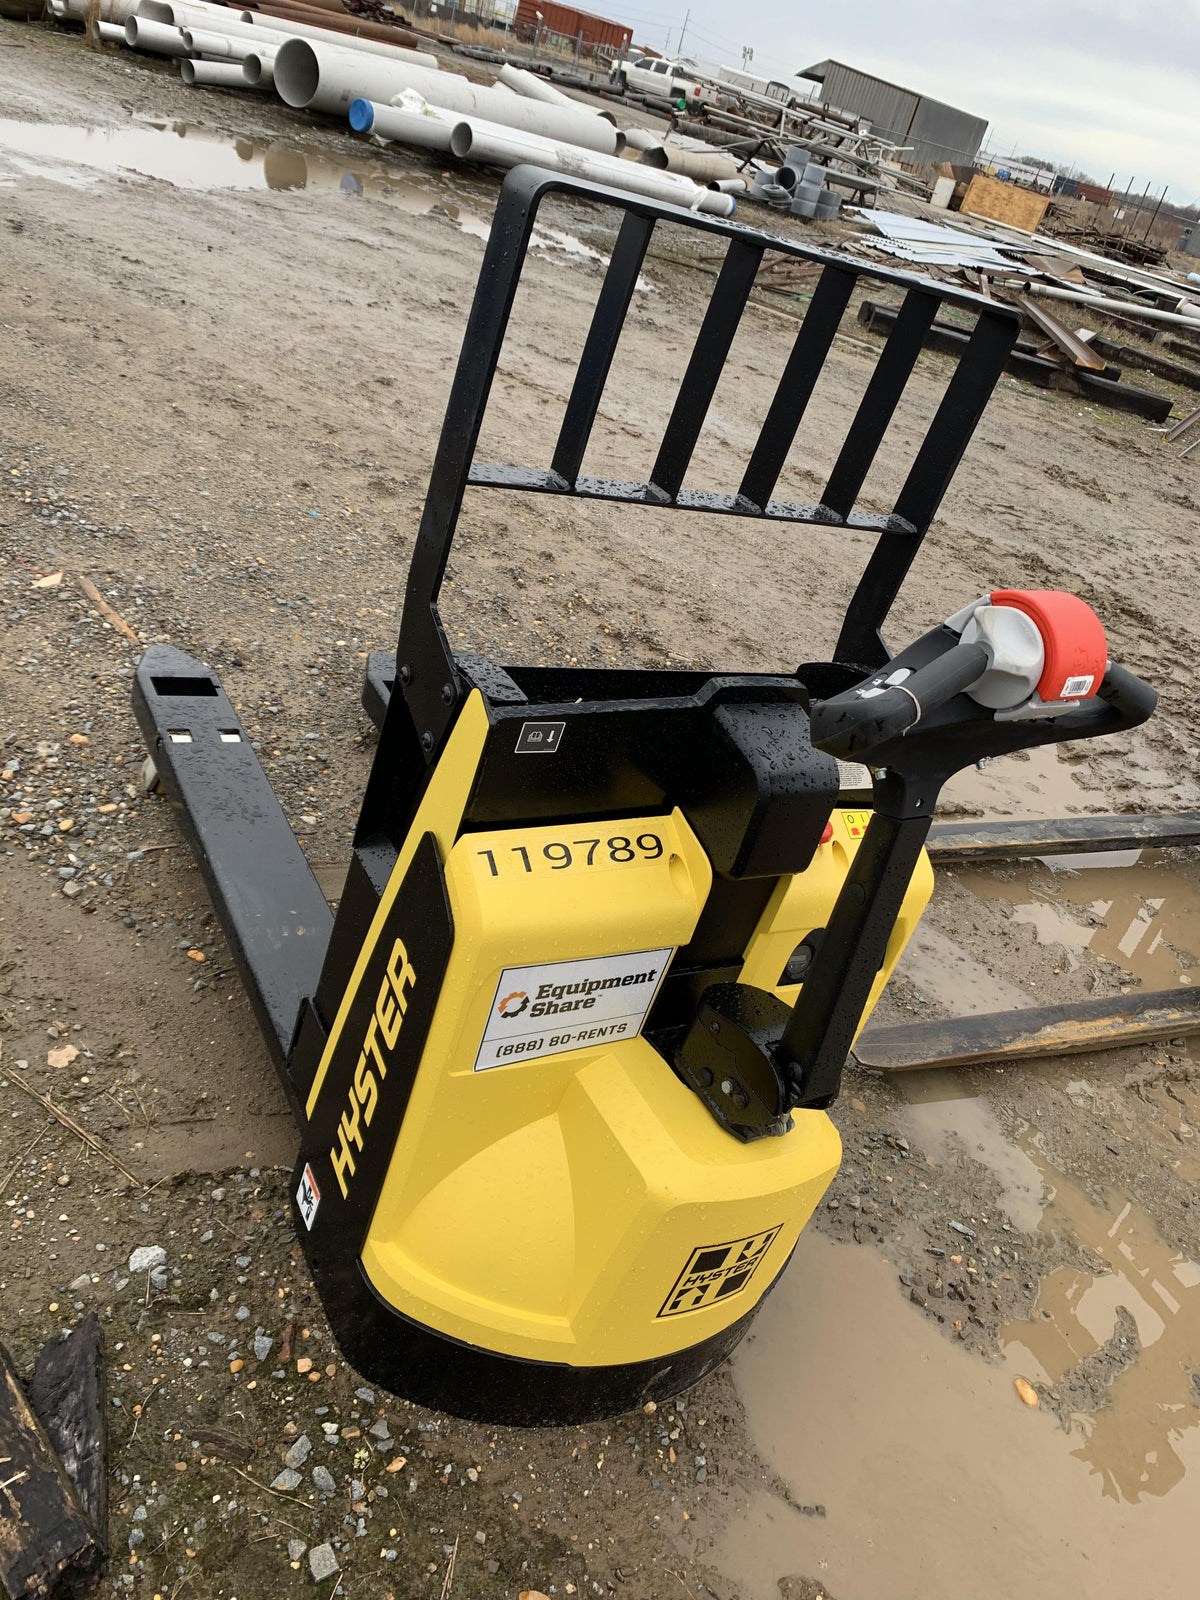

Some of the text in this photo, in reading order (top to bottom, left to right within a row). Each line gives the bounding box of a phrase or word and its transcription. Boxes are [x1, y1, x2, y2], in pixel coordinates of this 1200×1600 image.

[477, 833, 663, 877] 119789
[535, 969, 658, 1001] Equipment
[529, 997, 596, 1018] Share
[495, 1022, 628, 1058] (888) 80-RENTS
[330, 937, 417, 1200] HYSTER
[682, 1255, 759, 1287] HYSTER
